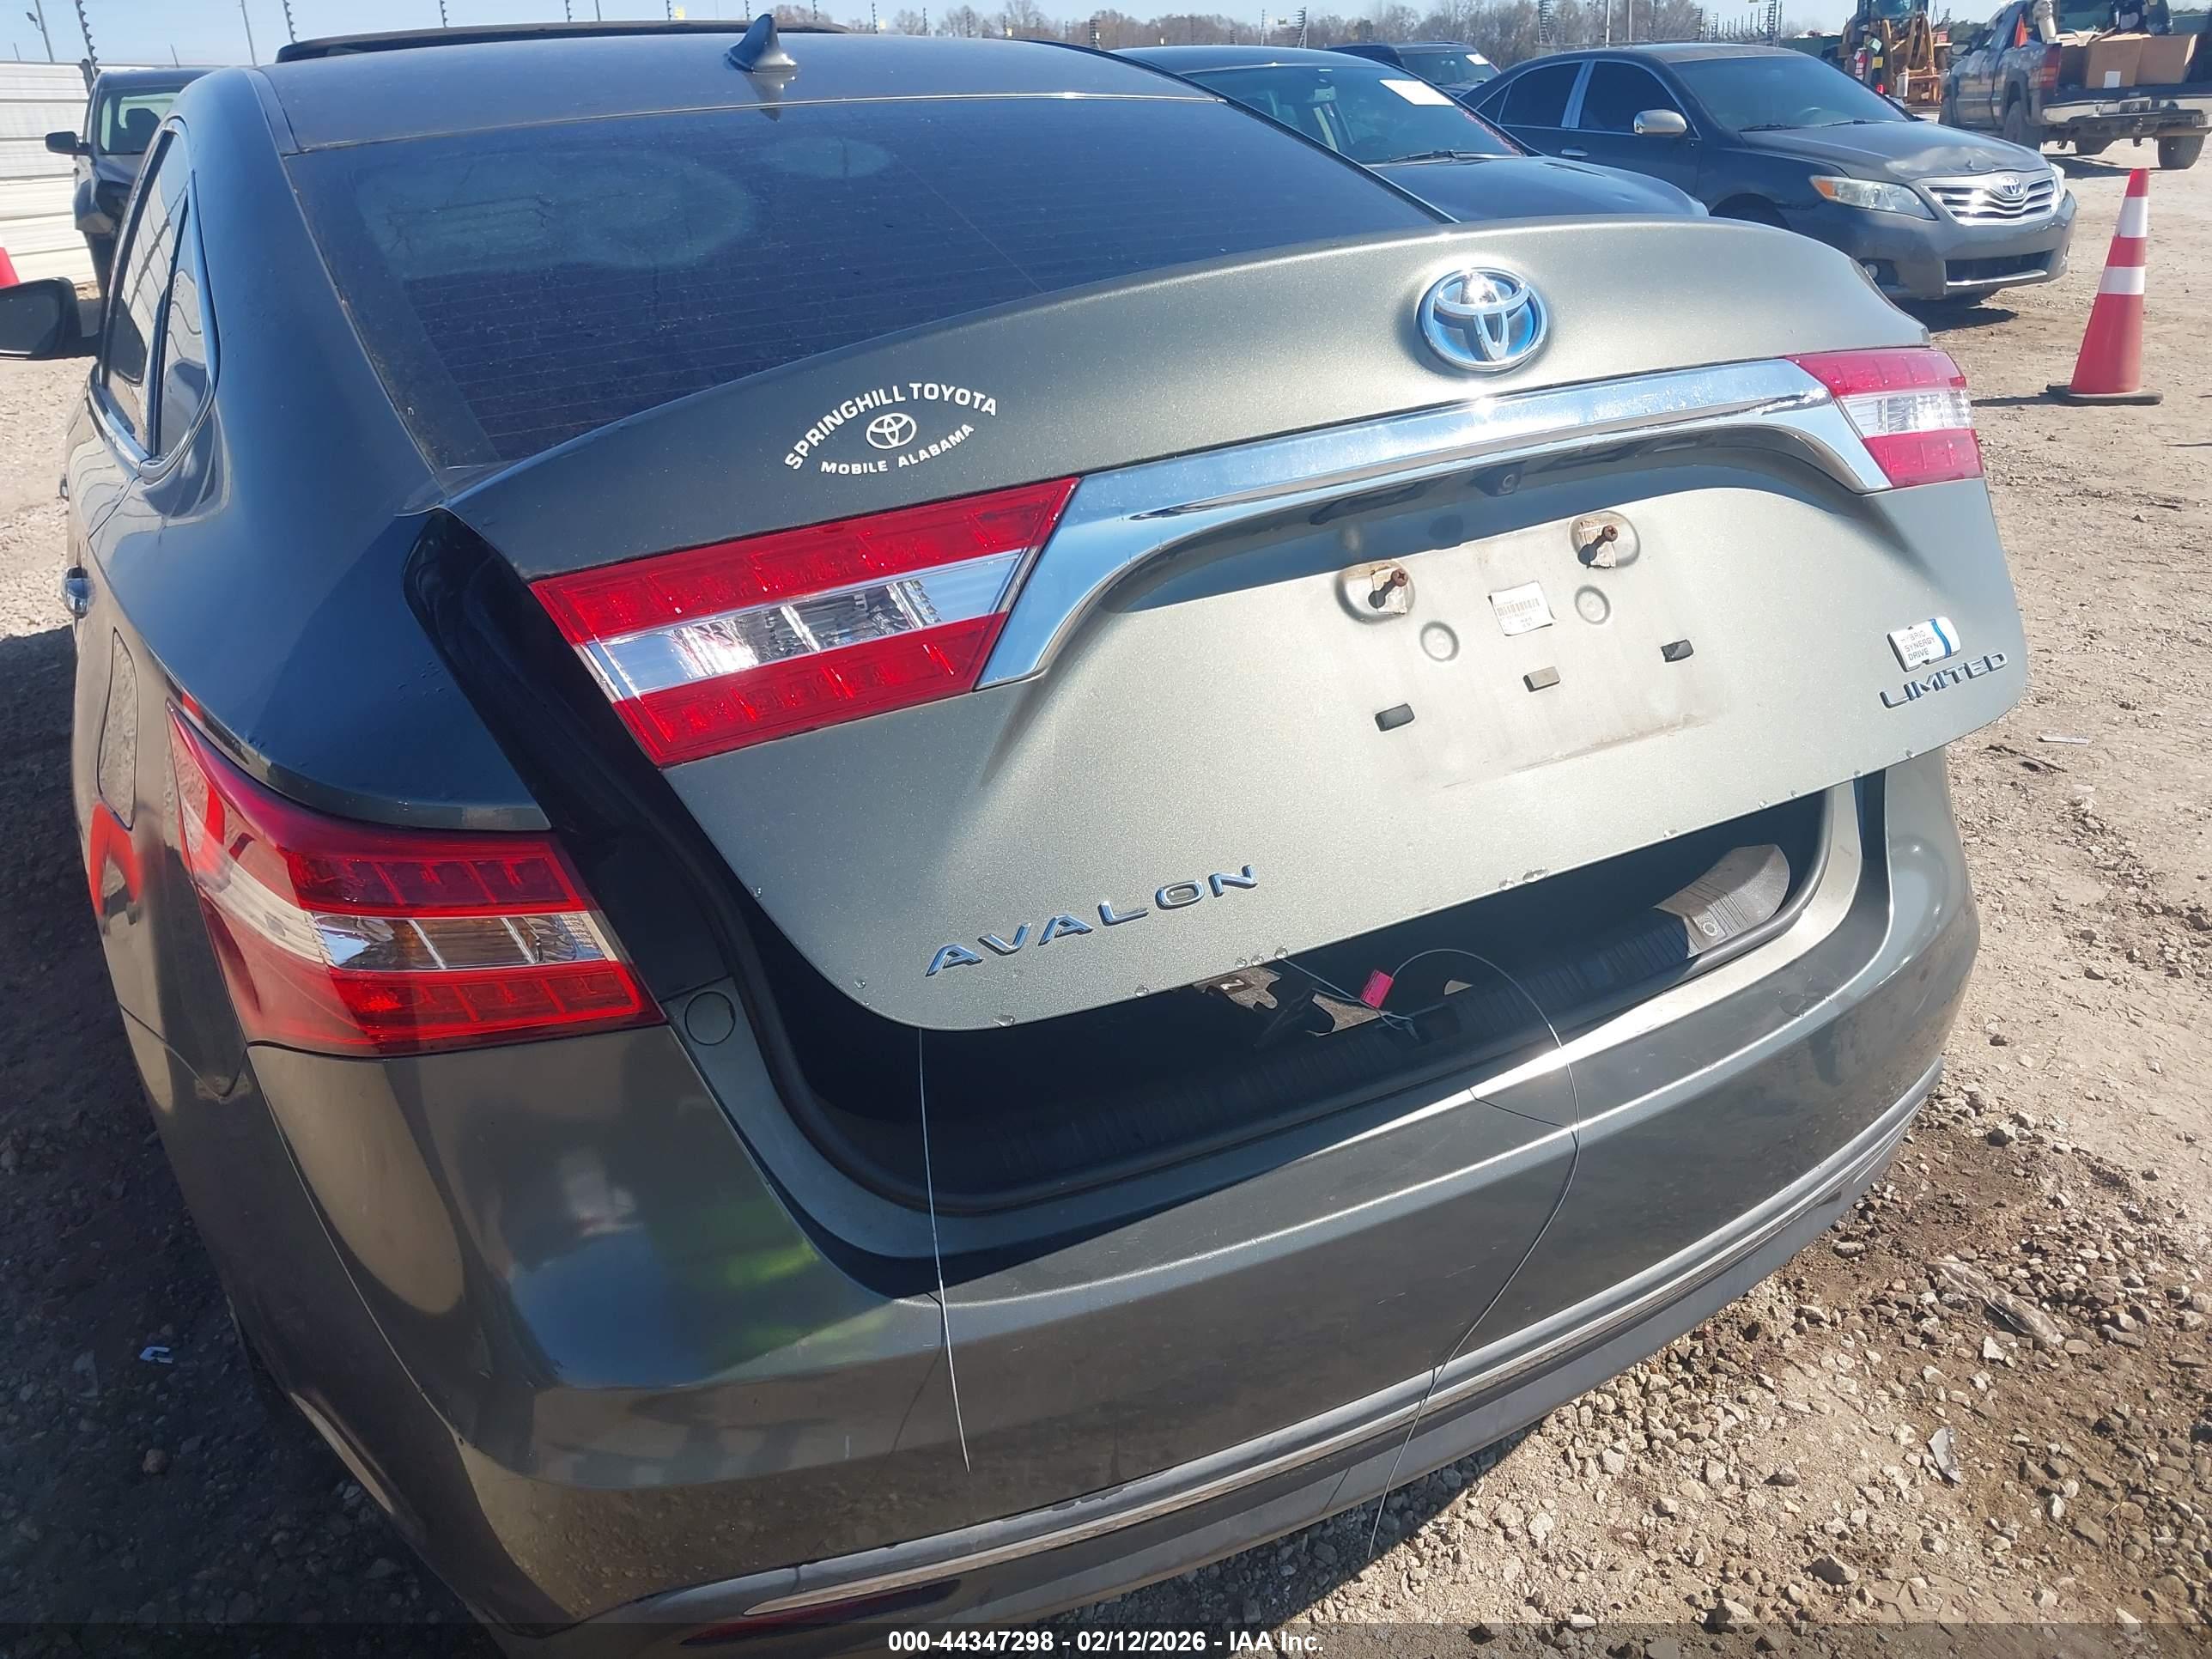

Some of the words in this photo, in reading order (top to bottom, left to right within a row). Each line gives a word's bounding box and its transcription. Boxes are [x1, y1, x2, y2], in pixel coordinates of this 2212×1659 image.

[784, 385, 907, 471] SPRINGHILL
[908, 382, 998, 416] TOYOTA
[819, 460, 889, 475] MOBILE
[897, 422, 975, 468] ALABAMA
[1904, 637, 1936, 653] SYNERGY
[1907, 647, 1930, 661] DRIVE
[1879, 651, 2008, 709] LIMITED
[925, 864, 1258, 978] AVALON
